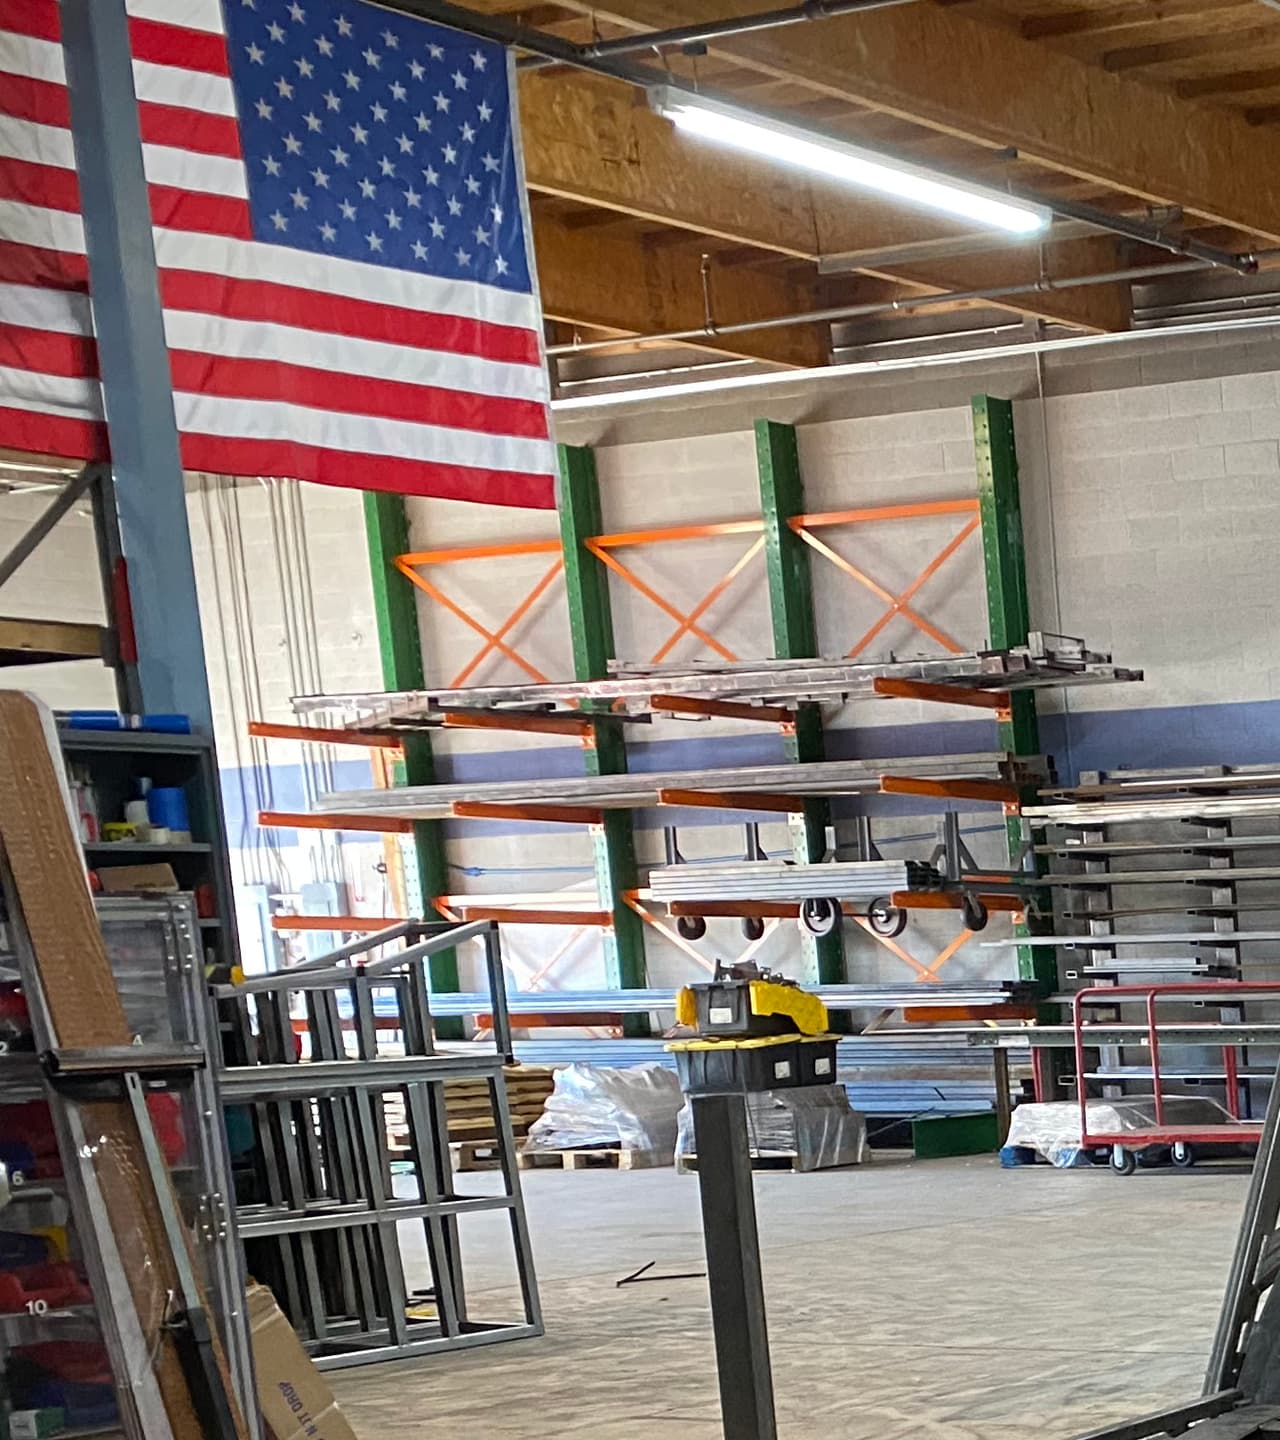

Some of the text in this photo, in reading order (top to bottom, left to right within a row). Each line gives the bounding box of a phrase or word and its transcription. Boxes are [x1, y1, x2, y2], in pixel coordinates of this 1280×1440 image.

[12, 1170, 24, 1186] 6
[25, 1299, 48, 1315] 10
[278, 1381, 304, 1414] DROP
